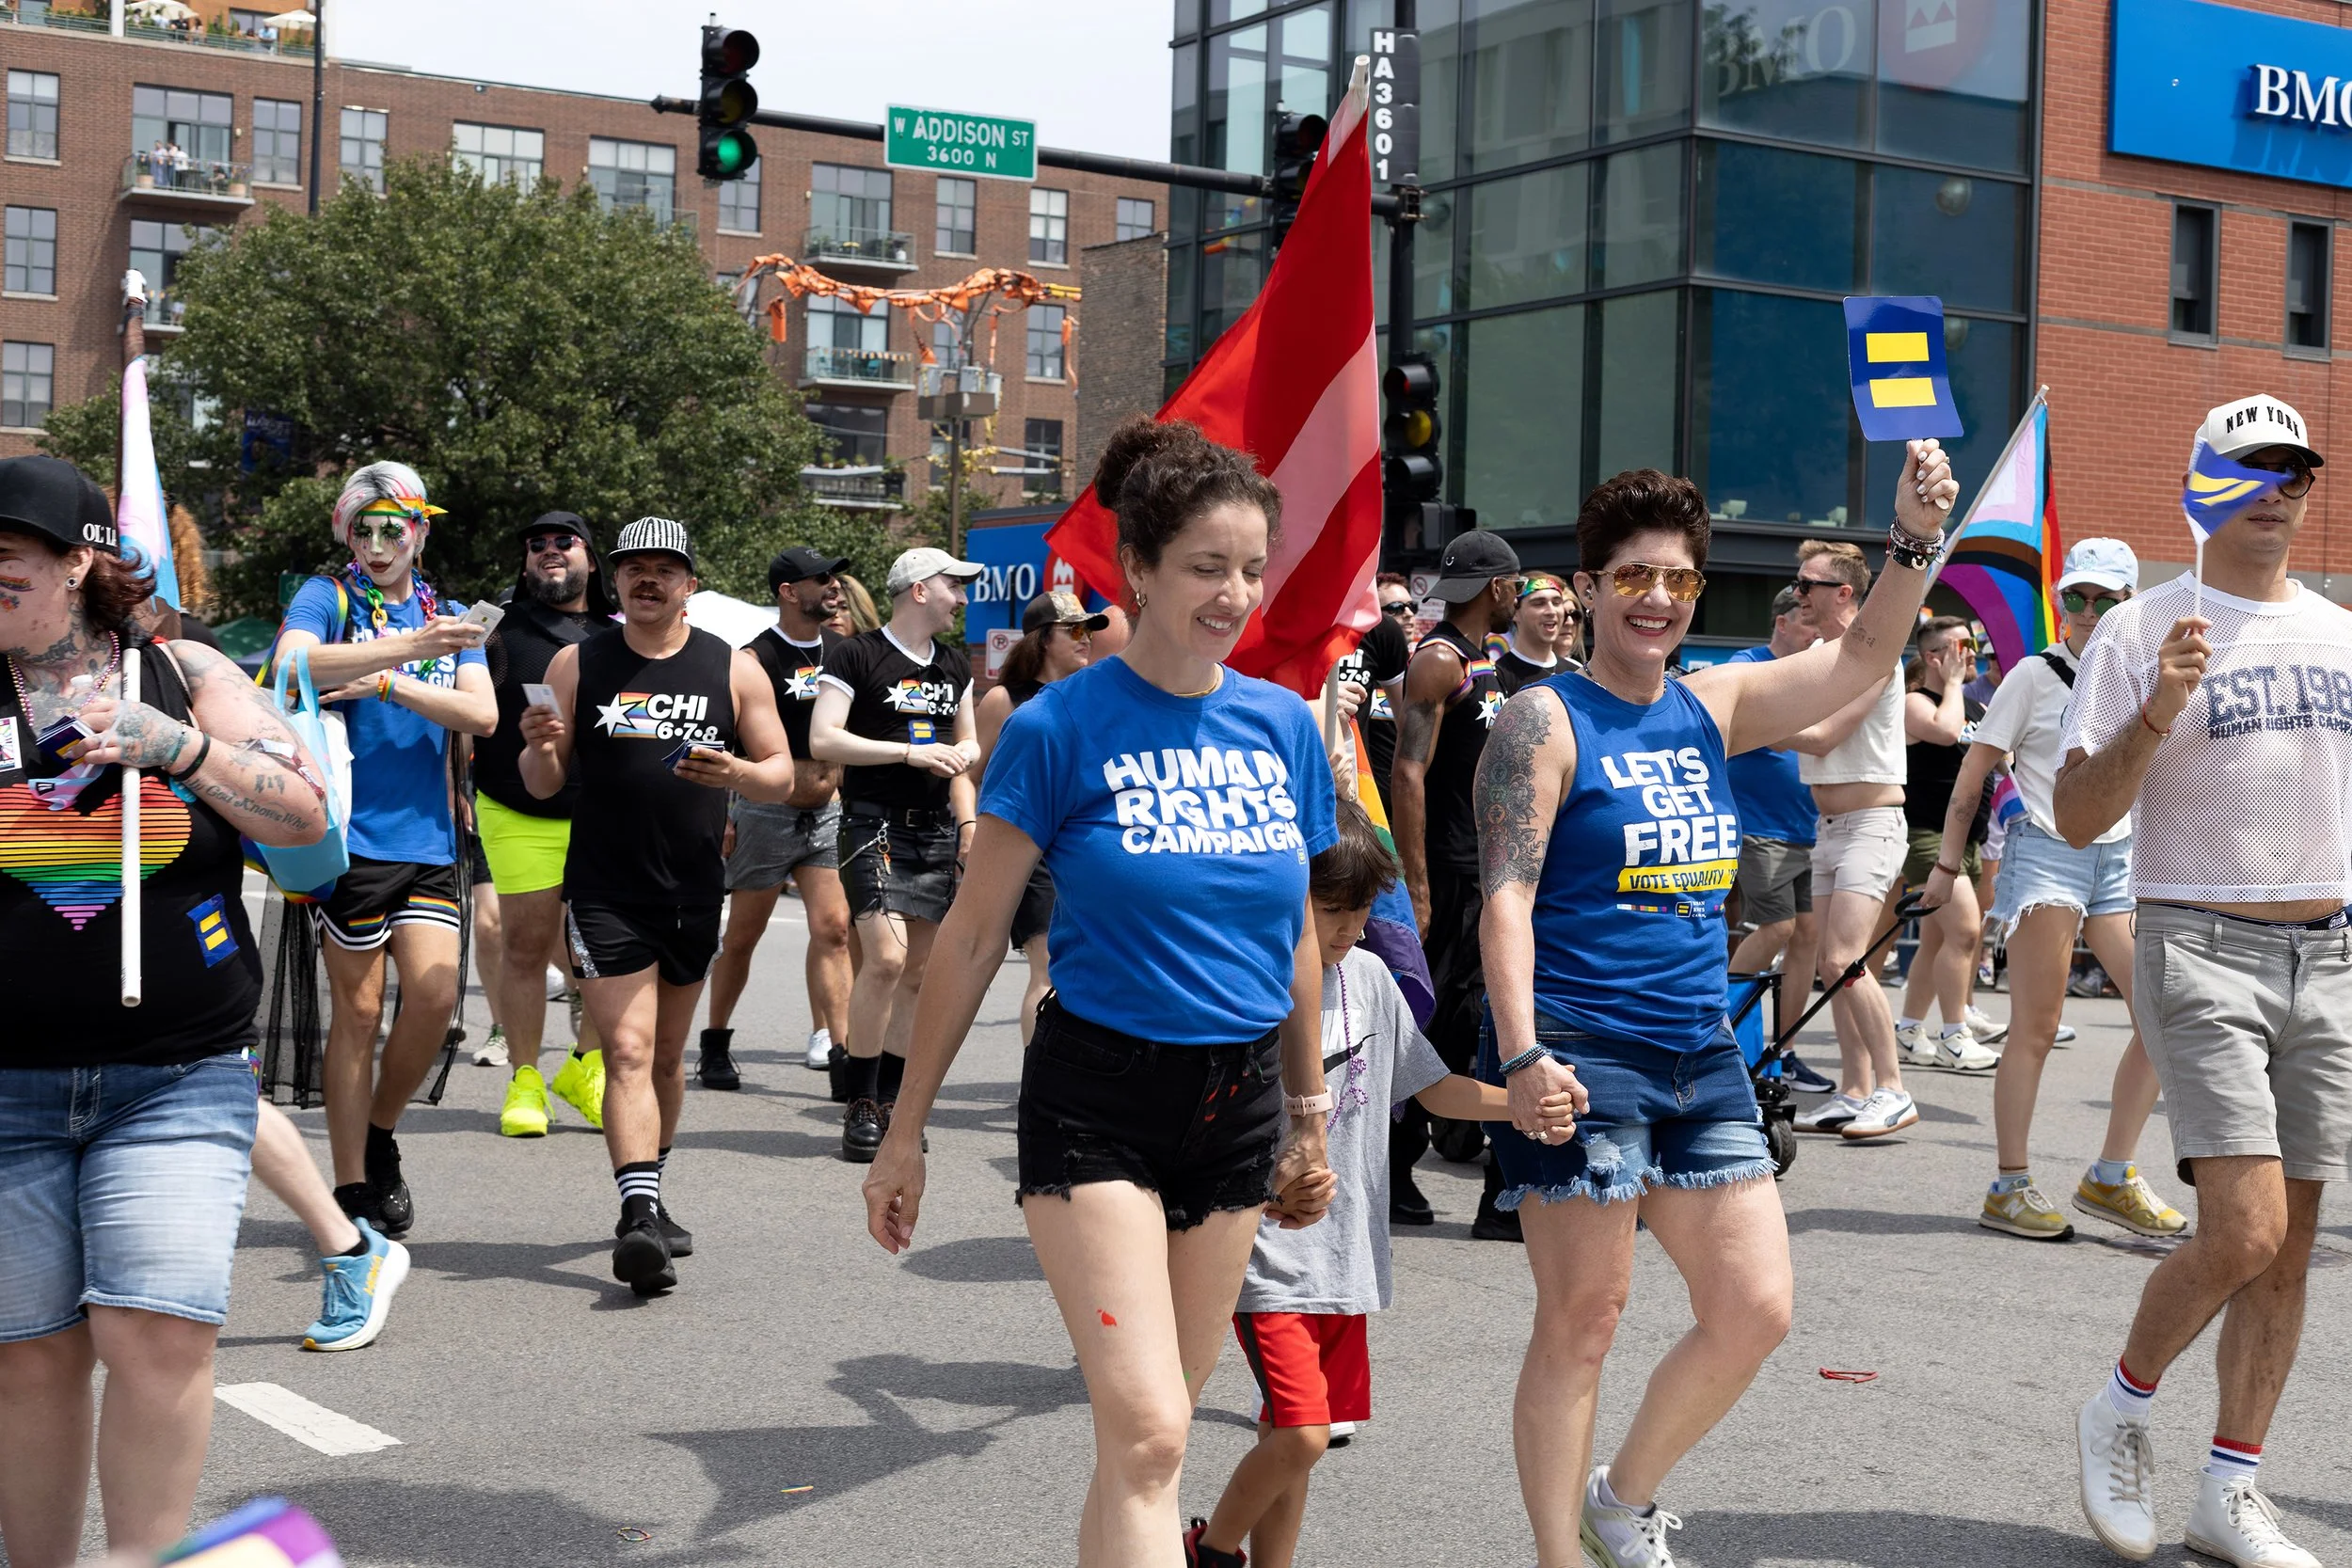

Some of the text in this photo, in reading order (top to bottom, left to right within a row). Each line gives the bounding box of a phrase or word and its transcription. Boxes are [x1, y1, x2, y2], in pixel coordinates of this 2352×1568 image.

[895, 116, 1029, 149] W ADDISON ST
[927, 145, 997, 169] 3600 N
[2226, 405, 2300, 439] NEW YORK
[973, 563, 1036, 603] BMO
[646, 693, 708, 721] CHI
[919, 681, 954, 702] CHI
[2201, 666, 2287, 726] EST.
[2209, 717, 2263, 739] HUMAN
[2265, 714, 2314, 731] RIGHTS
[1103, 746, 1287, 792] HUMAN
[1600, 747, 1709, 789] LET'S
[1115, 784, 1297, 830] RIGHTS
[1642, 783, 1714, 818] GET
[1121, 821, 1303, 855] CAMPAIGN
[1629, 874, 1670, 890] VOTE
[1672, 867, 1724, 891] EQUALITY
[1321, 1008, 1361, 1051] IKE
